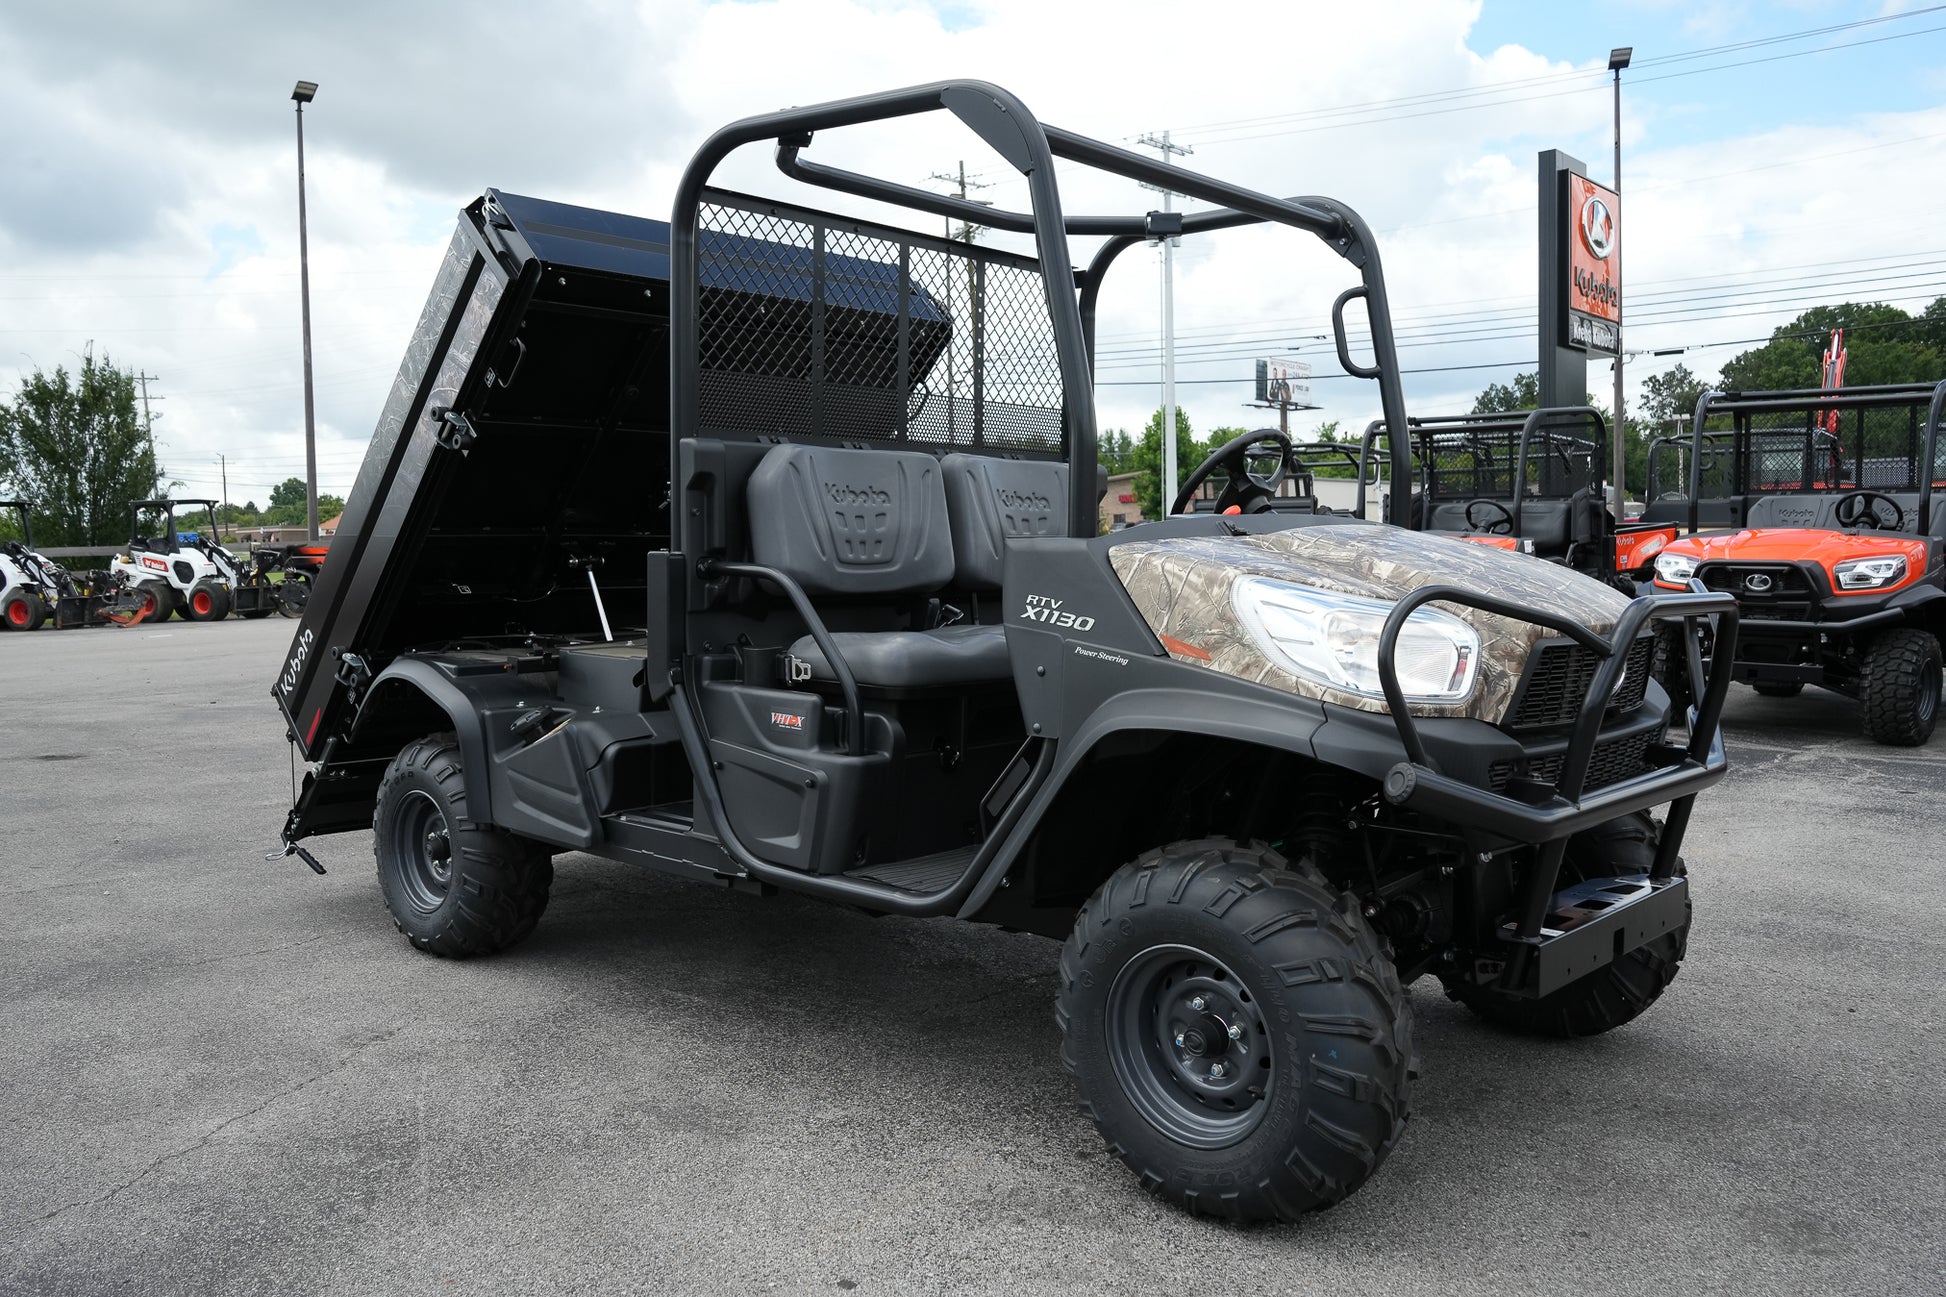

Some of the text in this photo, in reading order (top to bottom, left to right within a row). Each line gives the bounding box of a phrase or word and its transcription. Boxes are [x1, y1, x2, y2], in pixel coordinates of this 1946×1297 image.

[1574, 265, 1618, 307] Kubota
[825, 482, 891, 505] Kubota
[997, 488, 1051, 511] Kubota
[1779, 508, 1815, 518] Kubota
[1025, 594, 1064, 609] RTV
[1020, 604, 1095, 632] X1130
[280, 628, 314, 696] Kubota
[1074, 646, 1129, 666] Power Steering
